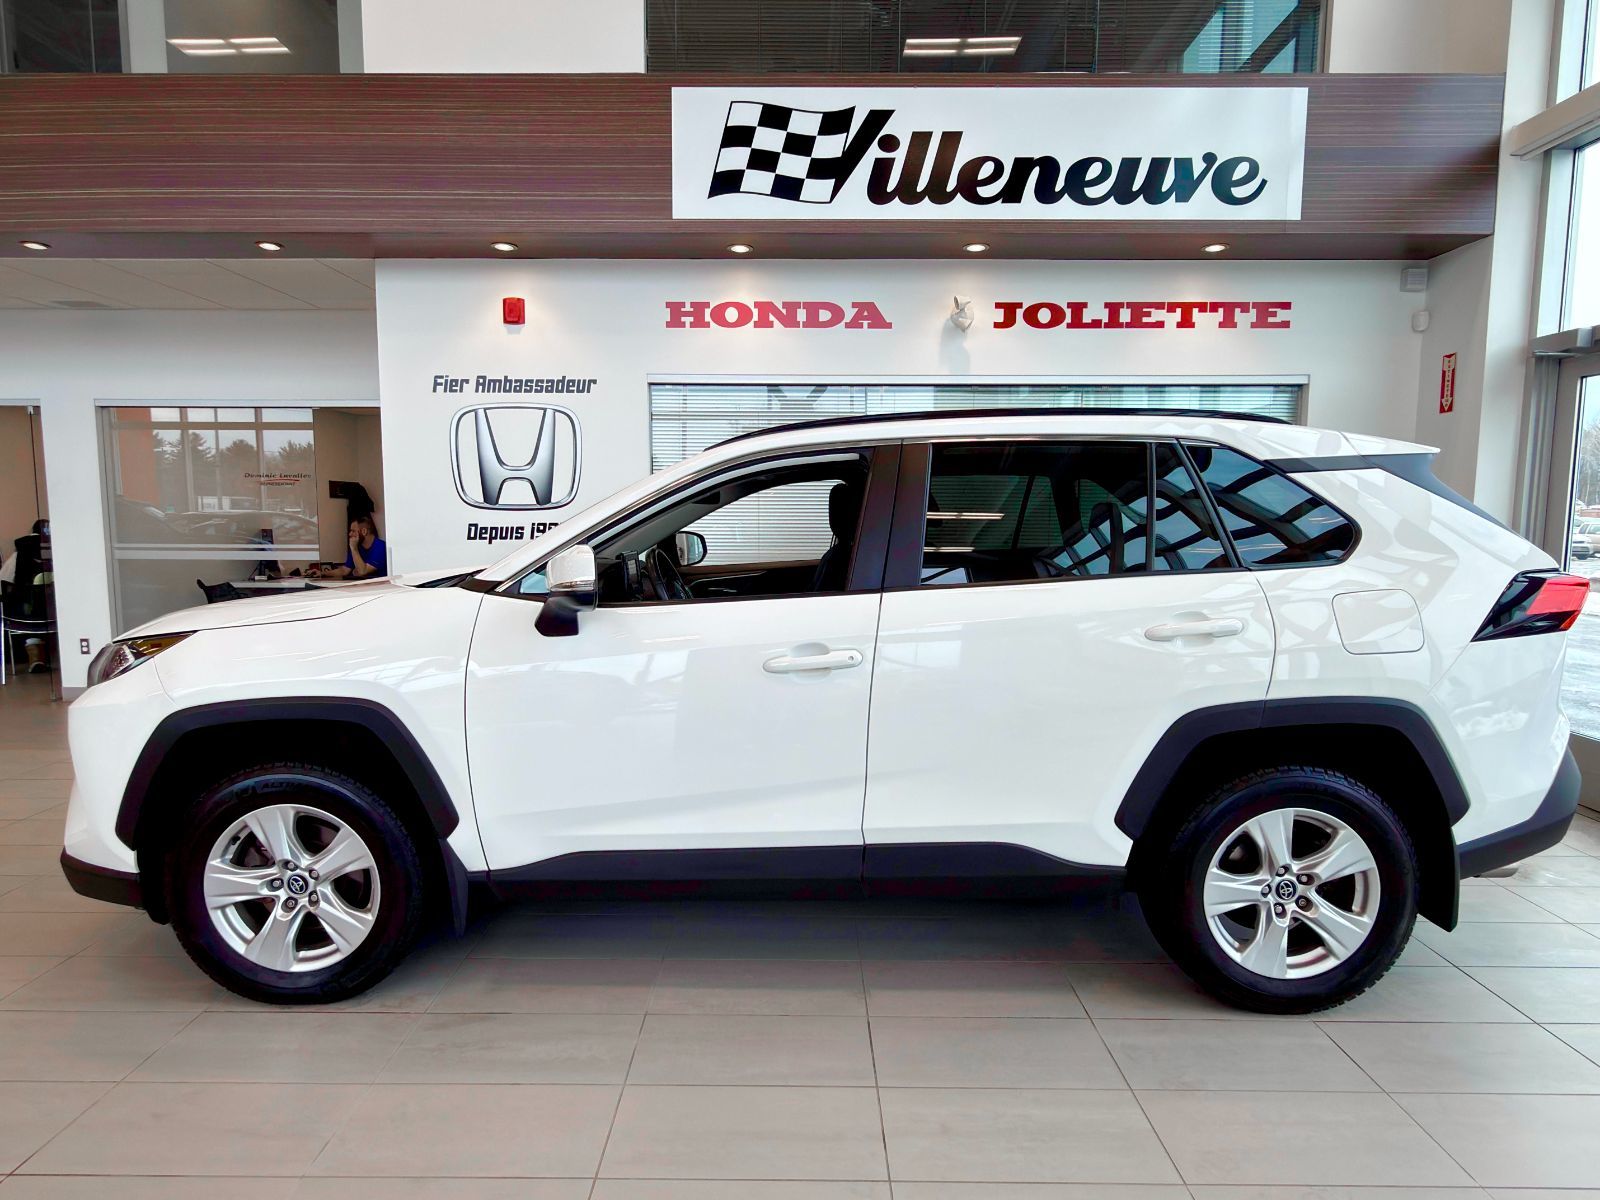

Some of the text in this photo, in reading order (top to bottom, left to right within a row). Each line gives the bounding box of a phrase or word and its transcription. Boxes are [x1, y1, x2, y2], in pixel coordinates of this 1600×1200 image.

[822, 108, 1268, 206] Villeneuve
[665, 301, 1292, 329] HONDA JOLIETTE
[432, 375, 598, 394] Fier Ambassadeur
[467, 523, 525, 544] Depuis
